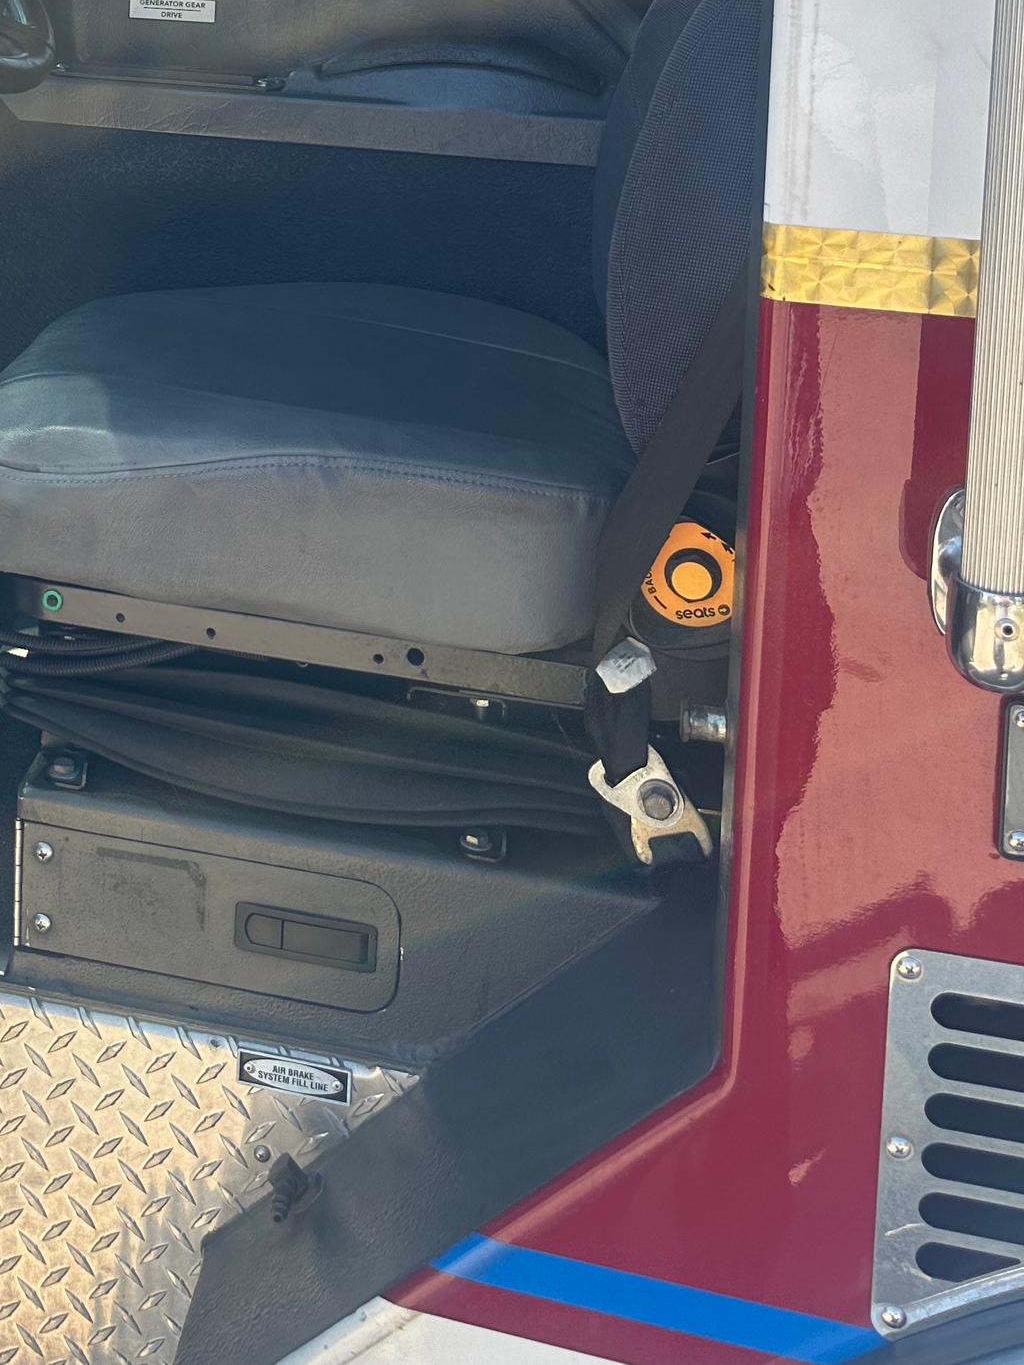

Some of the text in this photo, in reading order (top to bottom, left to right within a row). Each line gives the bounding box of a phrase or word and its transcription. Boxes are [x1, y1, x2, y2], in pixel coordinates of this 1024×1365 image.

[139, 0, 206, 9] GENERATOR GEAR
[160, 11, 183, 19] DRIVE
[675, 606, 716, 620] seats
[272, 1065, 314, 1080] AIR BRAKE
[257, 1070, 328, 1092] SYSTEM FILL LINE
